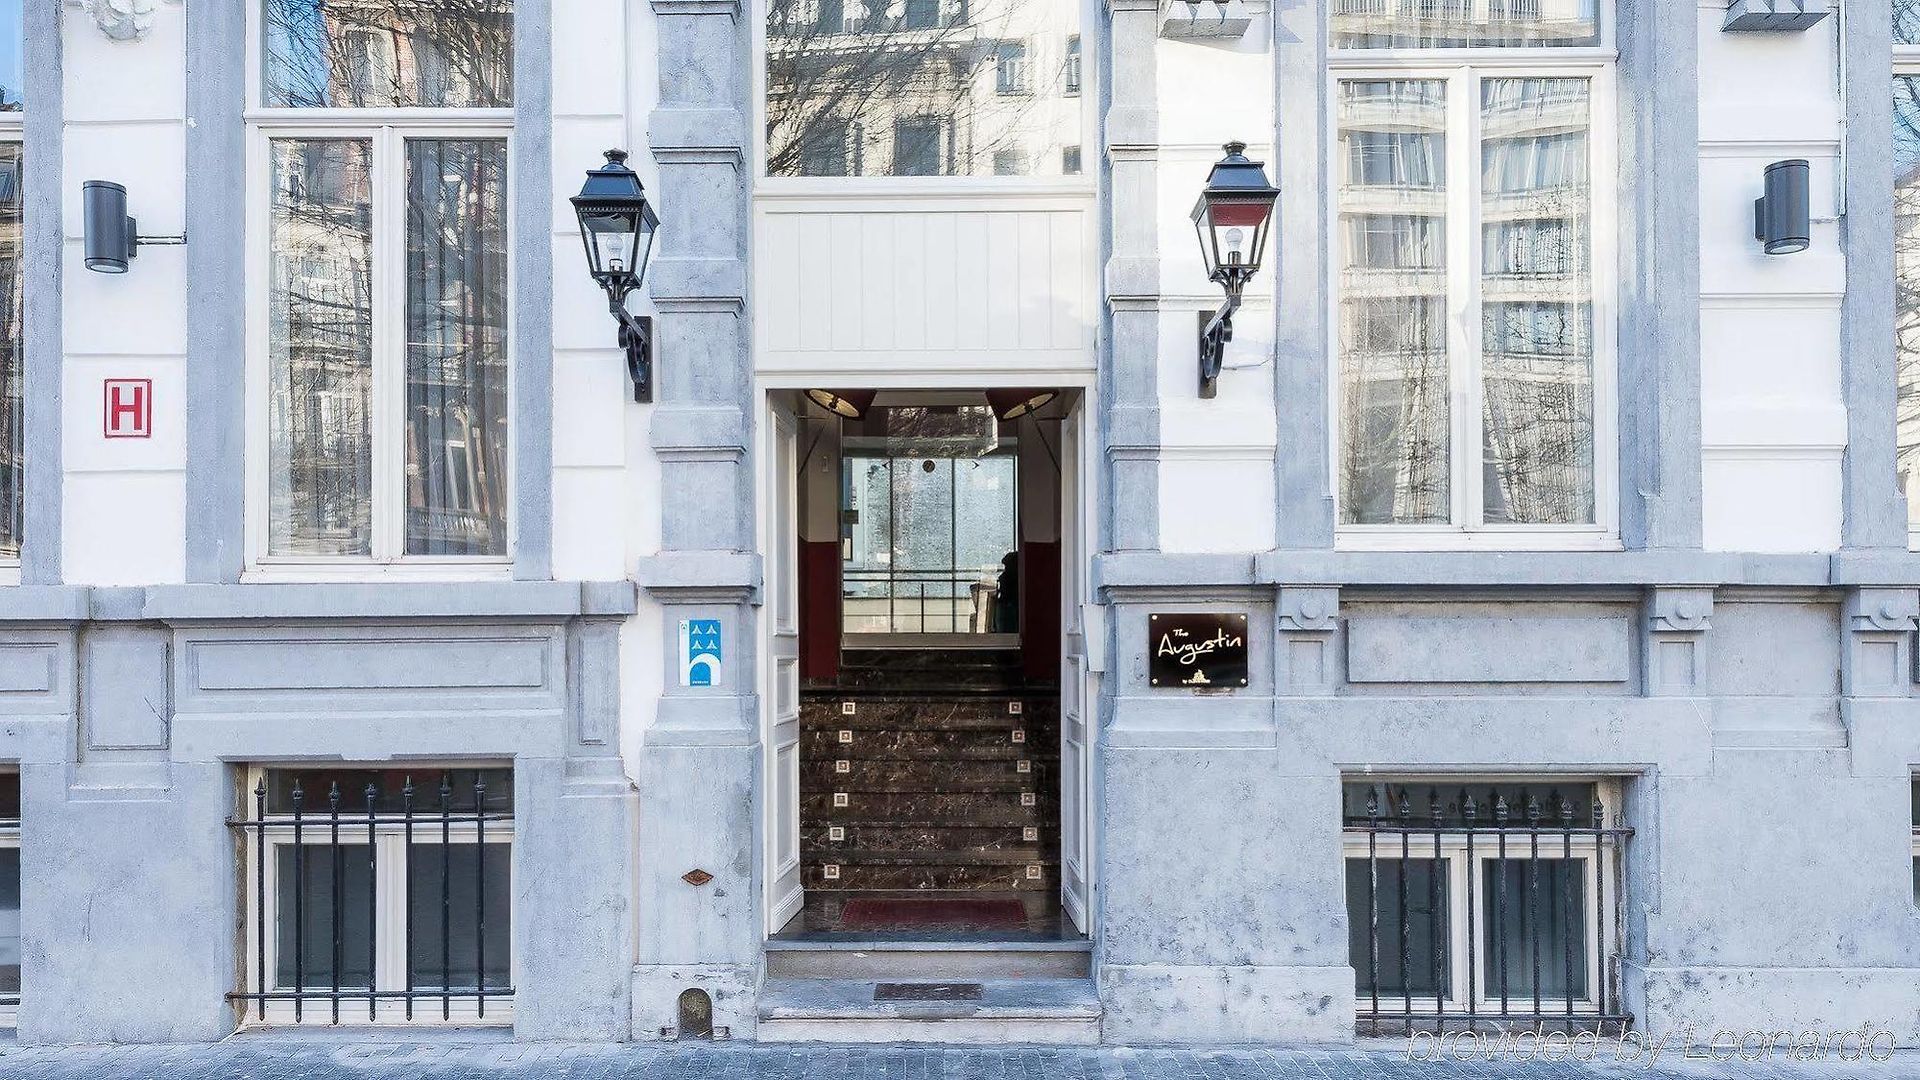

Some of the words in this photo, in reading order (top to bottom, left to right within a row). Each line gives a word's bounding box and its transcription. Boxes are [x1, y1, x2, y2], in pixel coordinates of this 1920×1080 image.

[111, 386, 143, 430] H
[1158, 627, 1241, 665] Augustin
[1173, 628, 1189, 636] The
